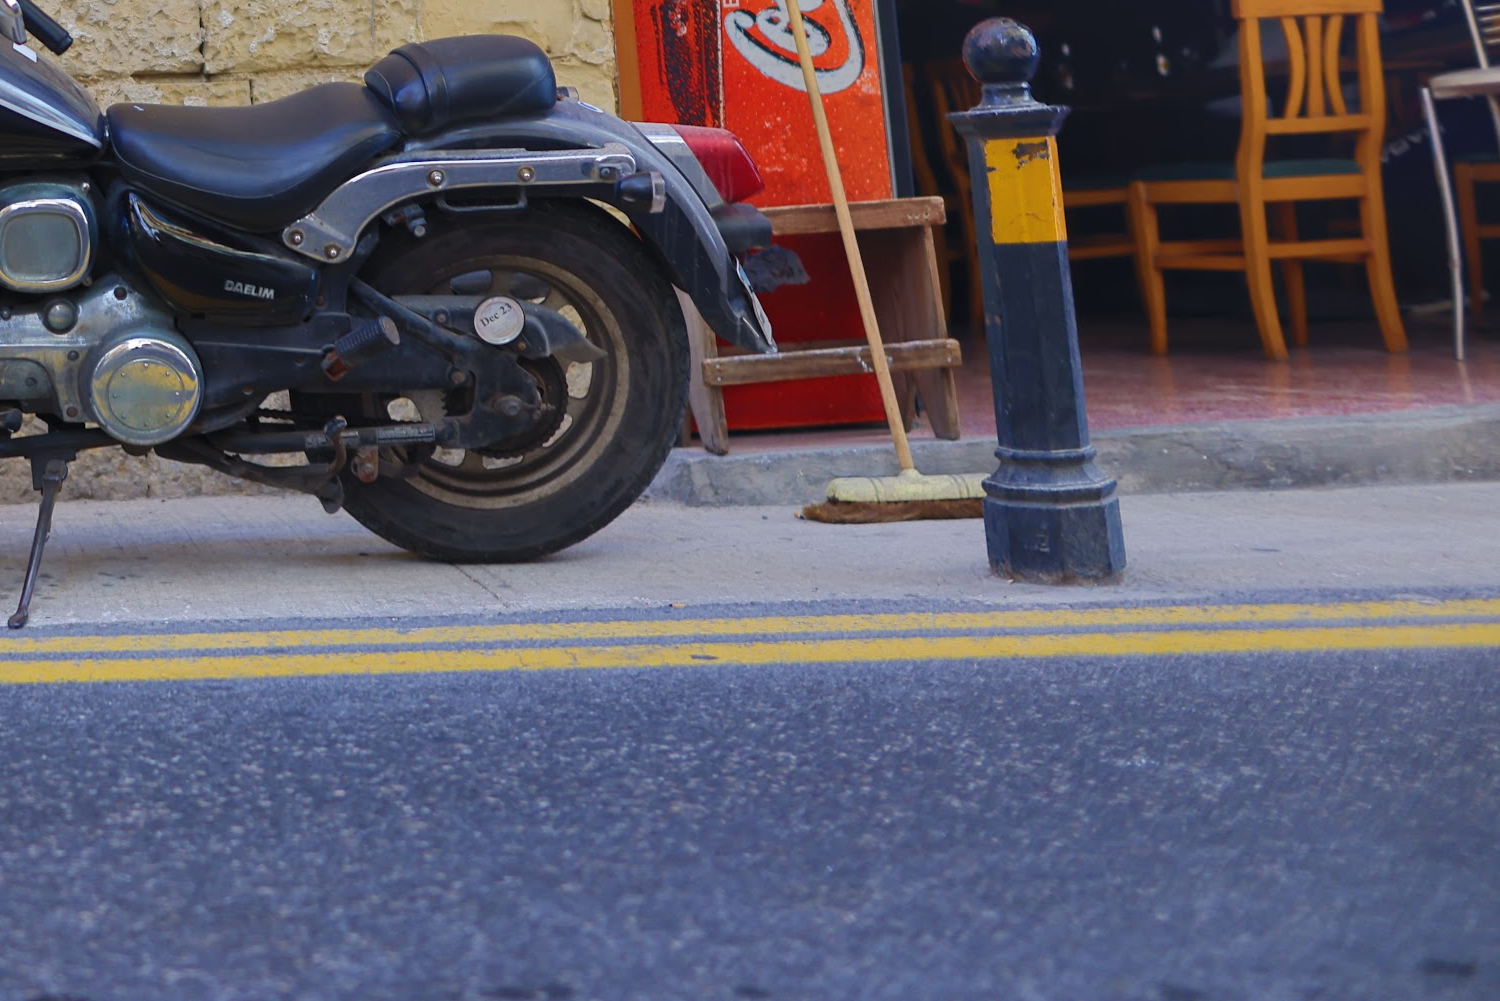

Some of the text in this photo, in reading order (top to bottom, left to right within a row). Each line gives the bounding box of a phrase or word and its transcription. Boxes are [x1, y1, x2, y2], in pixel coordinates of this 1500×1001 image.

[224, 279, 275, 300] DAELIM
[480, 302, 513, 327] Dec 23
